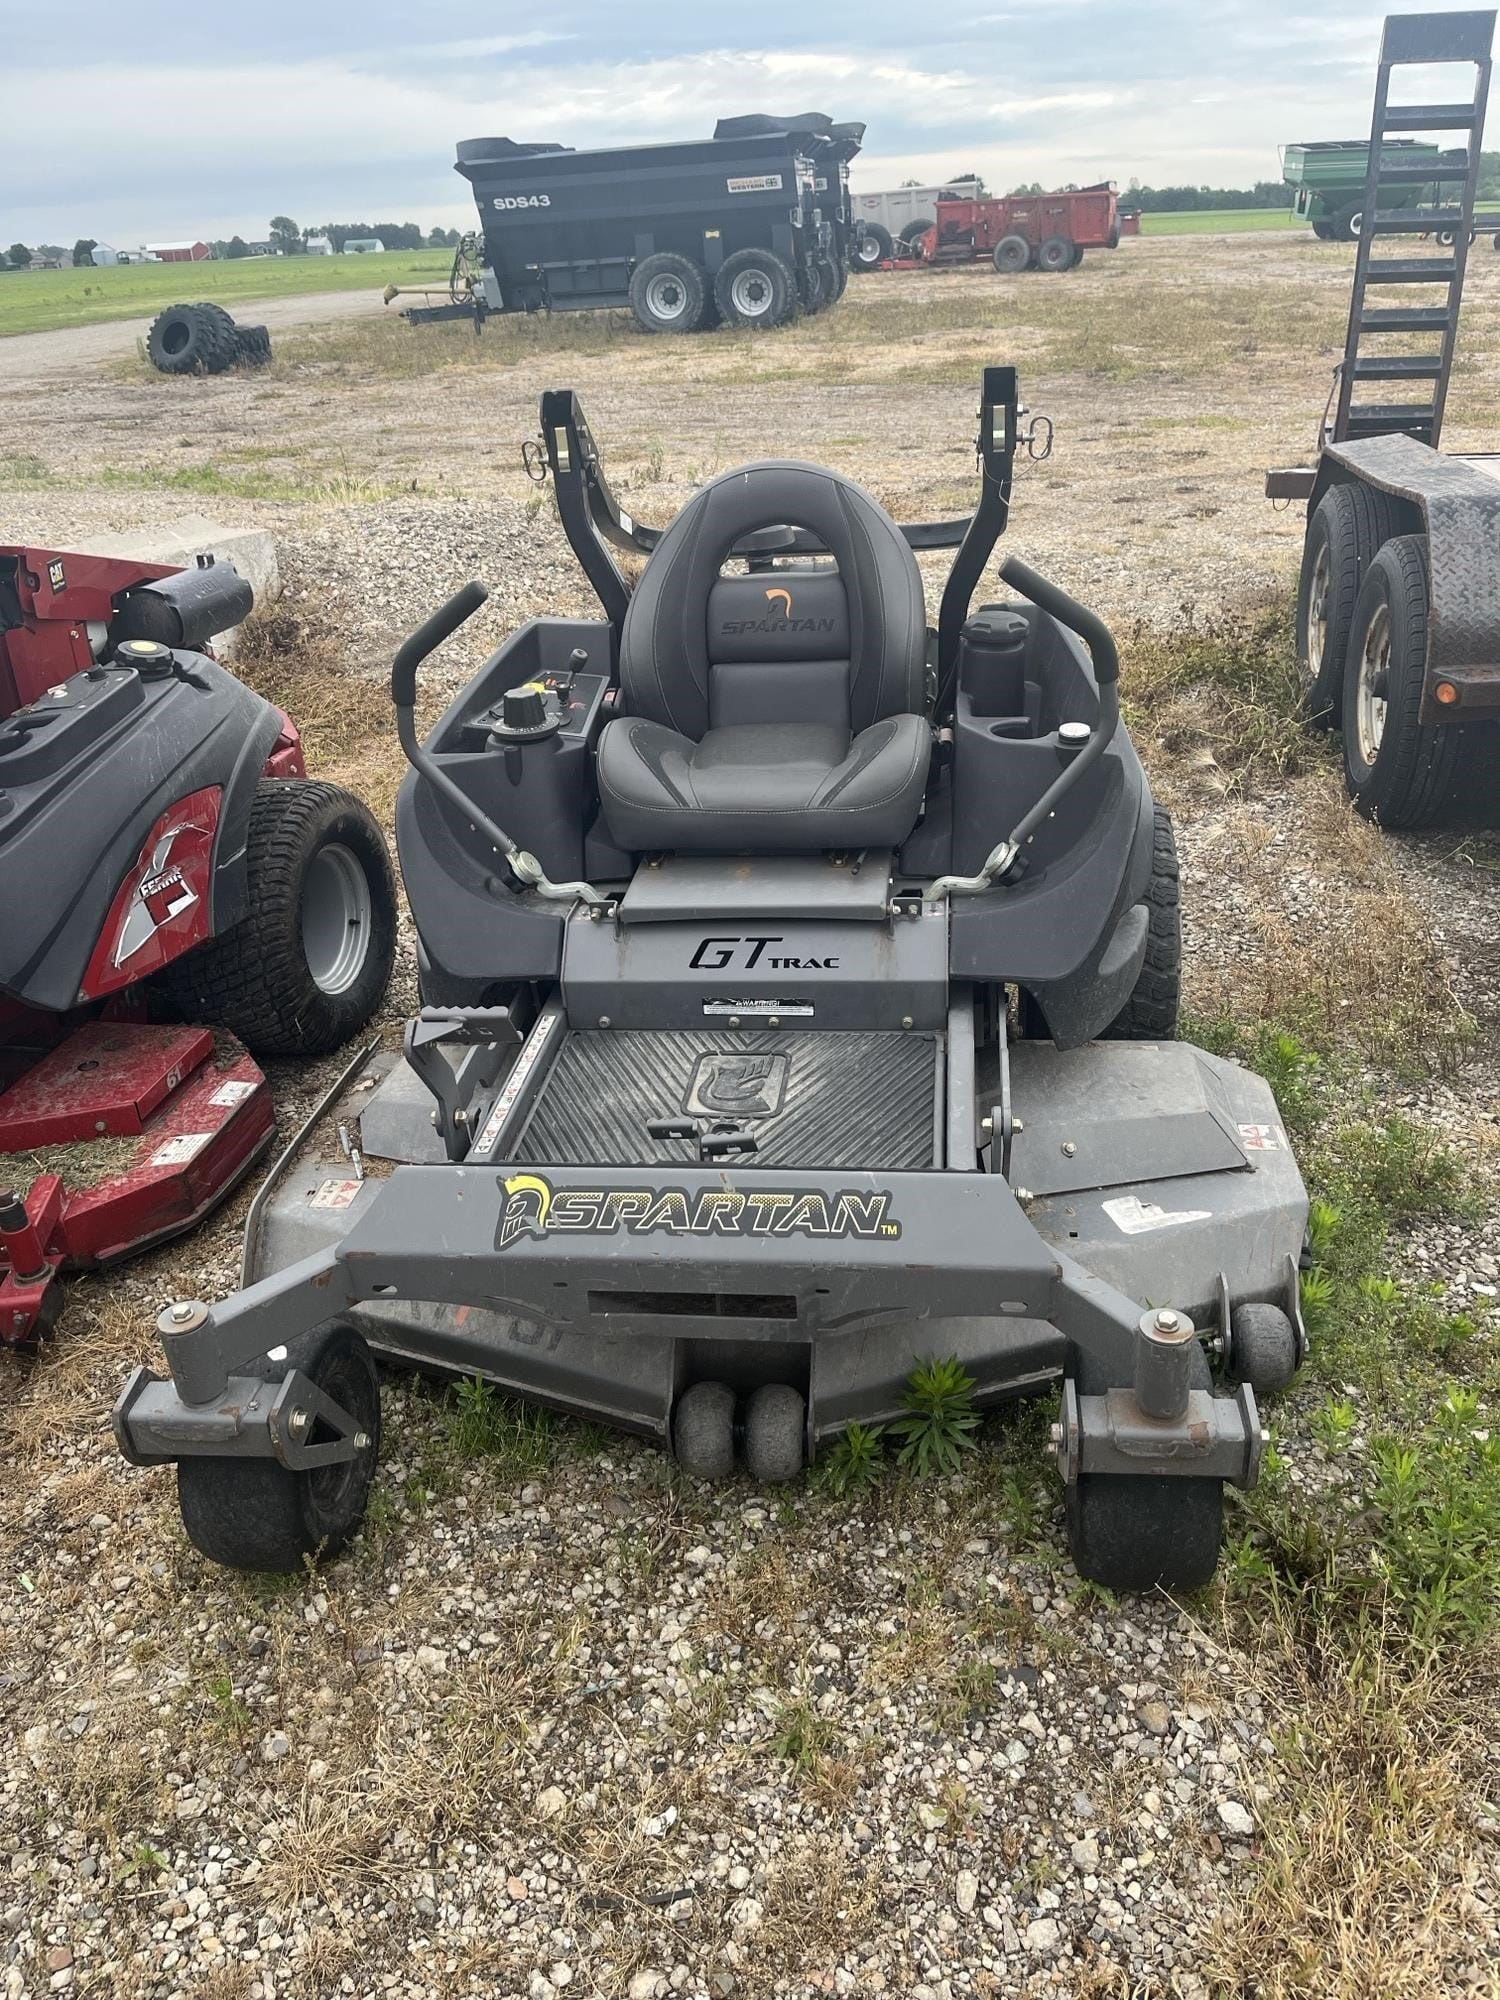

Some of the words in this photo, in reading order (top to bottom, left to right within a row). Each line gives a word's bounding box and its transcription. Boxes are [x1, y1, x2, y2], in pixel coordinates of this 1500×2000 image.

[493, 194, 551, 210] SDS43
[49, 562, 64, 584] CAT
[720, 618, 834, 635] SPARTAN
[689, 937, 784, 969] GT
[768, 957, 841, 969] TRAC
[544, 1192, 889, 1234] SPARTAN
